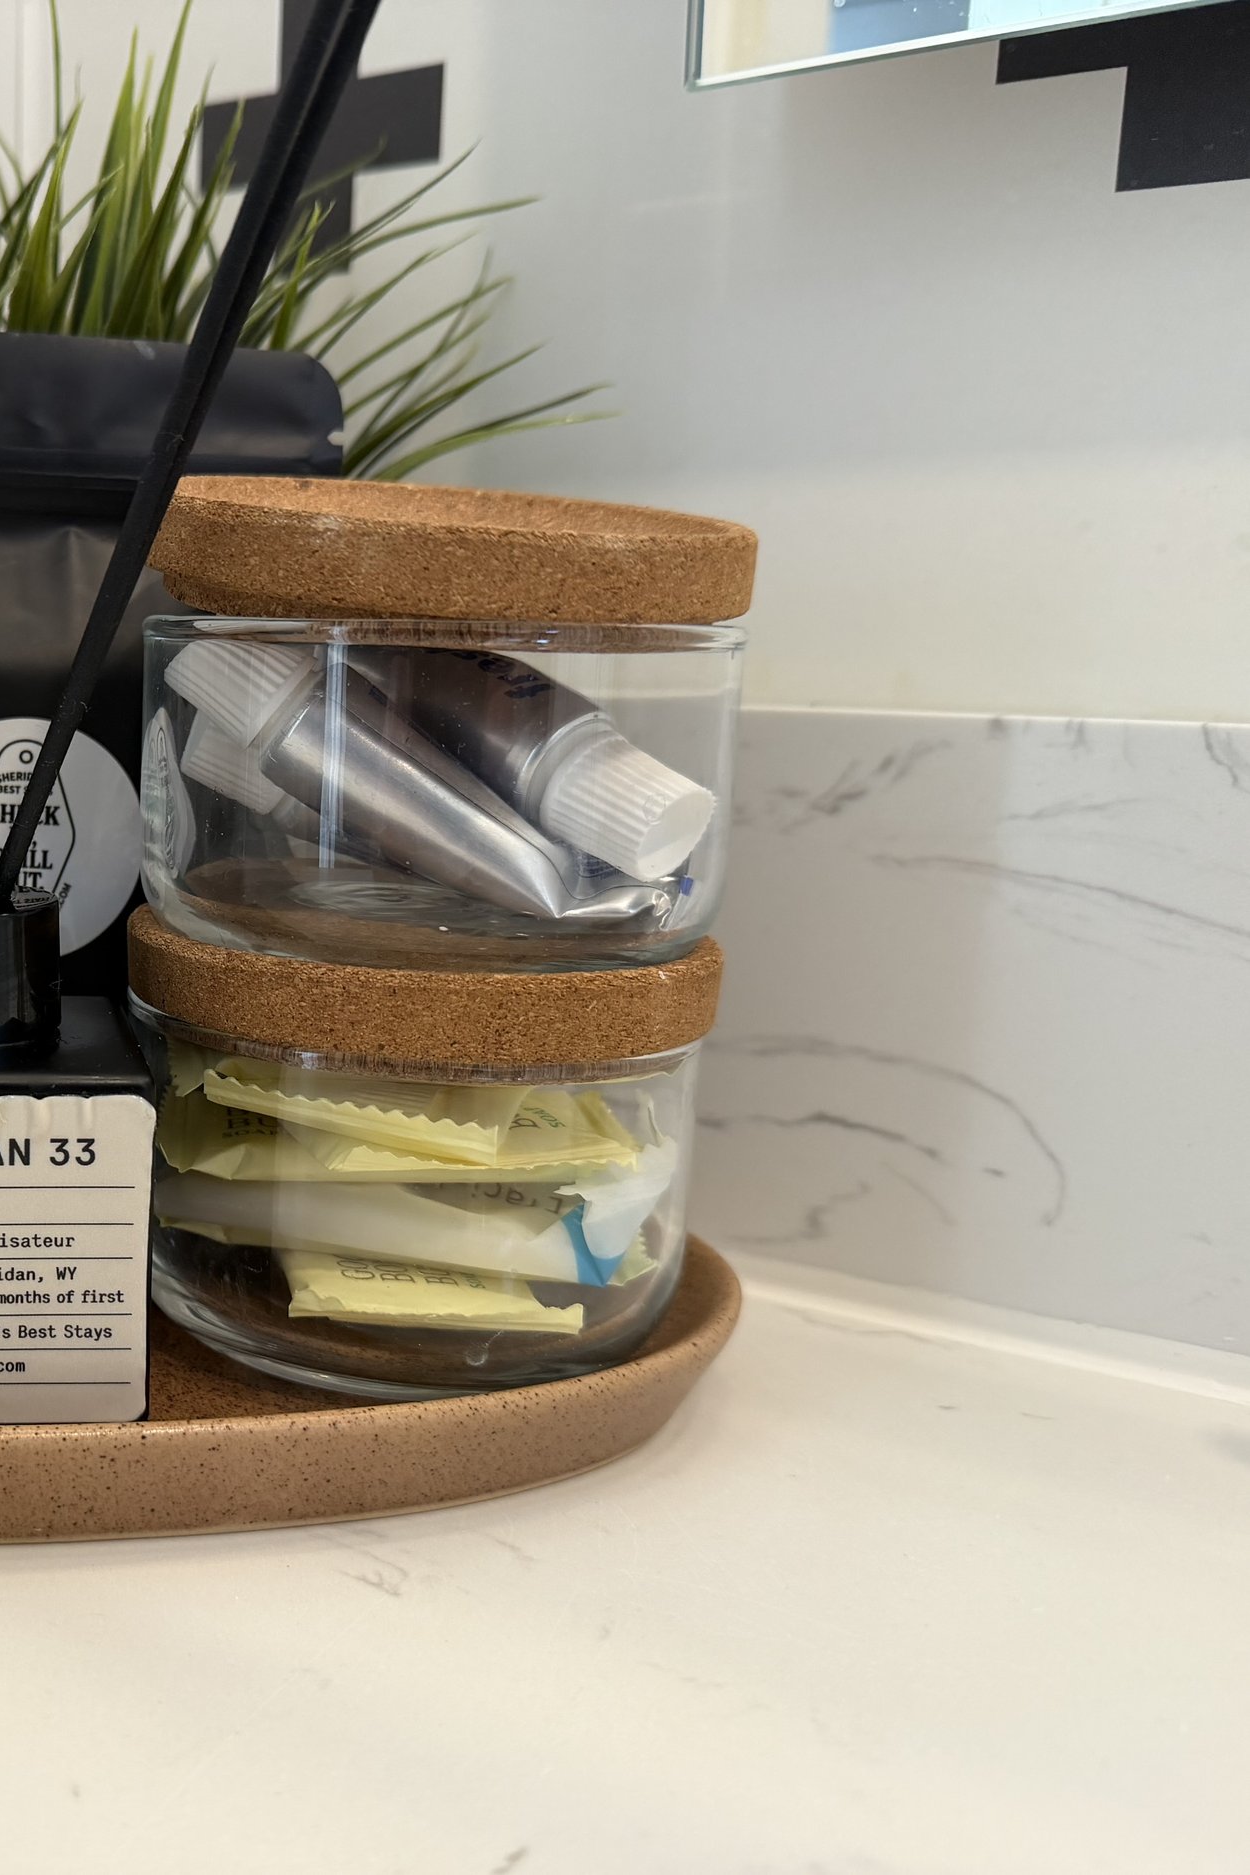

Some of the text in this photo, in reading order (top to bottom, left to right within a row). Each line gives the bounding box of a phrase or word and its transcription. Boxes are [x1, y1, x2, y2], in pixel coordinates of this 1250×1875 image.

[49, 1137, 96, 1167] 33
[55, 1266, 78, 1281] WY
[56, 1289, 76, 1304] of
[80, 1289, 125, 1304] first
[17, 1324, 57, 1339] Best
[63, 1324, 113, 1340] Stays
